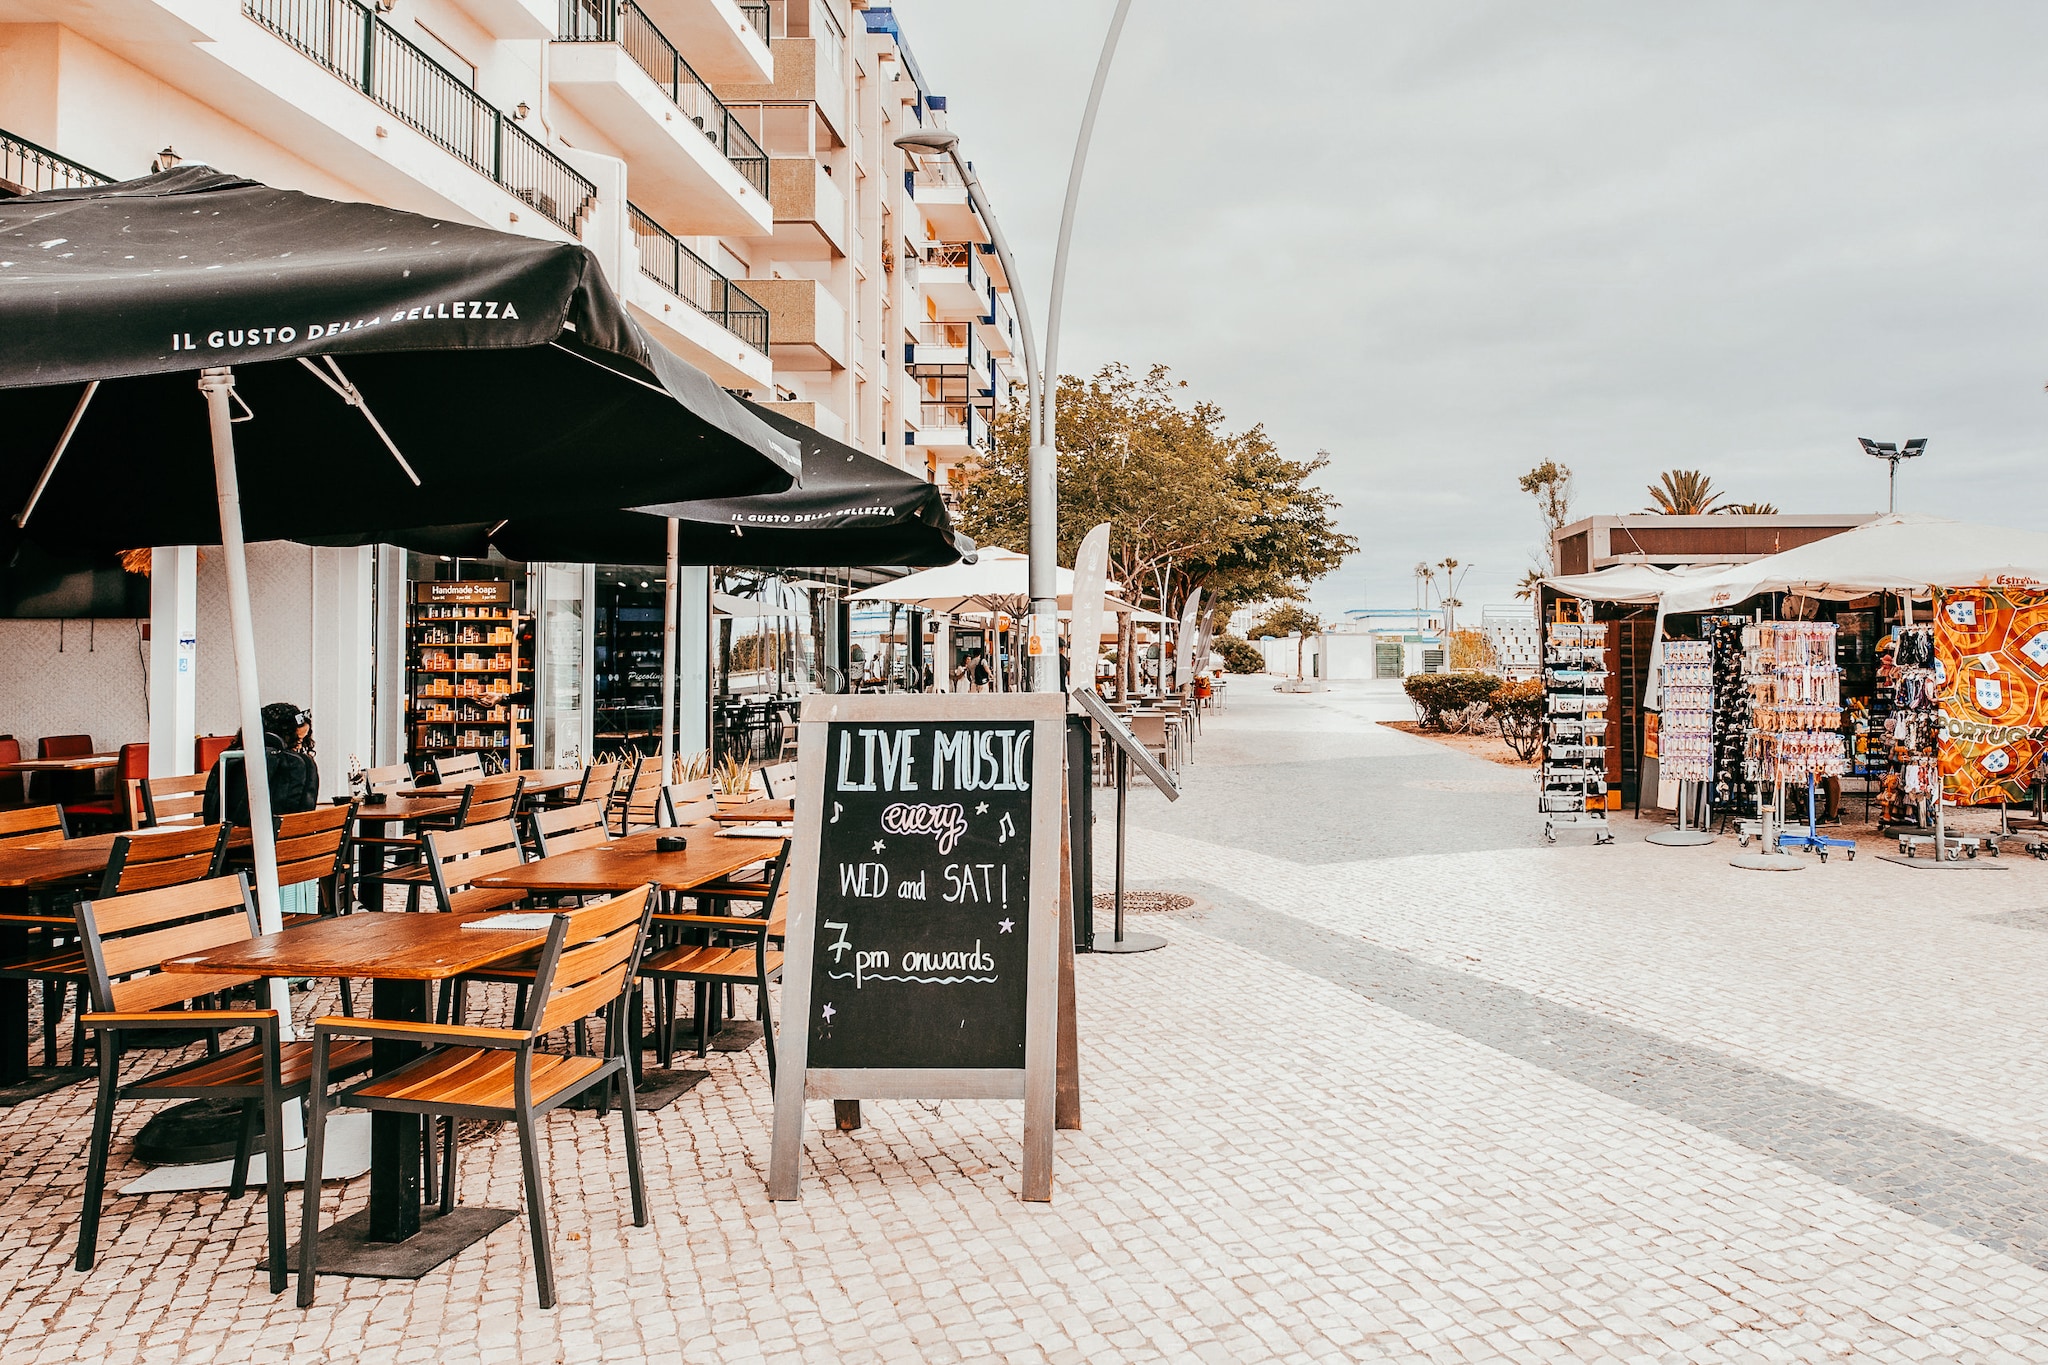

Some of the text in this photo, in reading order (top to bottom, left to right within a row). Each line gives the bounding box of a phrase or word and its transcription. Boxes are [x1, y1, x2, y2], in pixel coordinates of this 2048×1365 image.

[172, 301, 520, 351] IL GUSTO DELLA BELLEZZA
[731, 506, 896, 523] IL GUSTO DELLA BELLEZZA
[432, 585, 497, 596] Handmade Soaps
[837, 728, 1032, 792] LIVE MUSIC
[884, 804, 965, 855] every
[839, 862, 889, 898] WED
[897, 870, 927, 900] and
[902, 938, 996, 972] onwards
